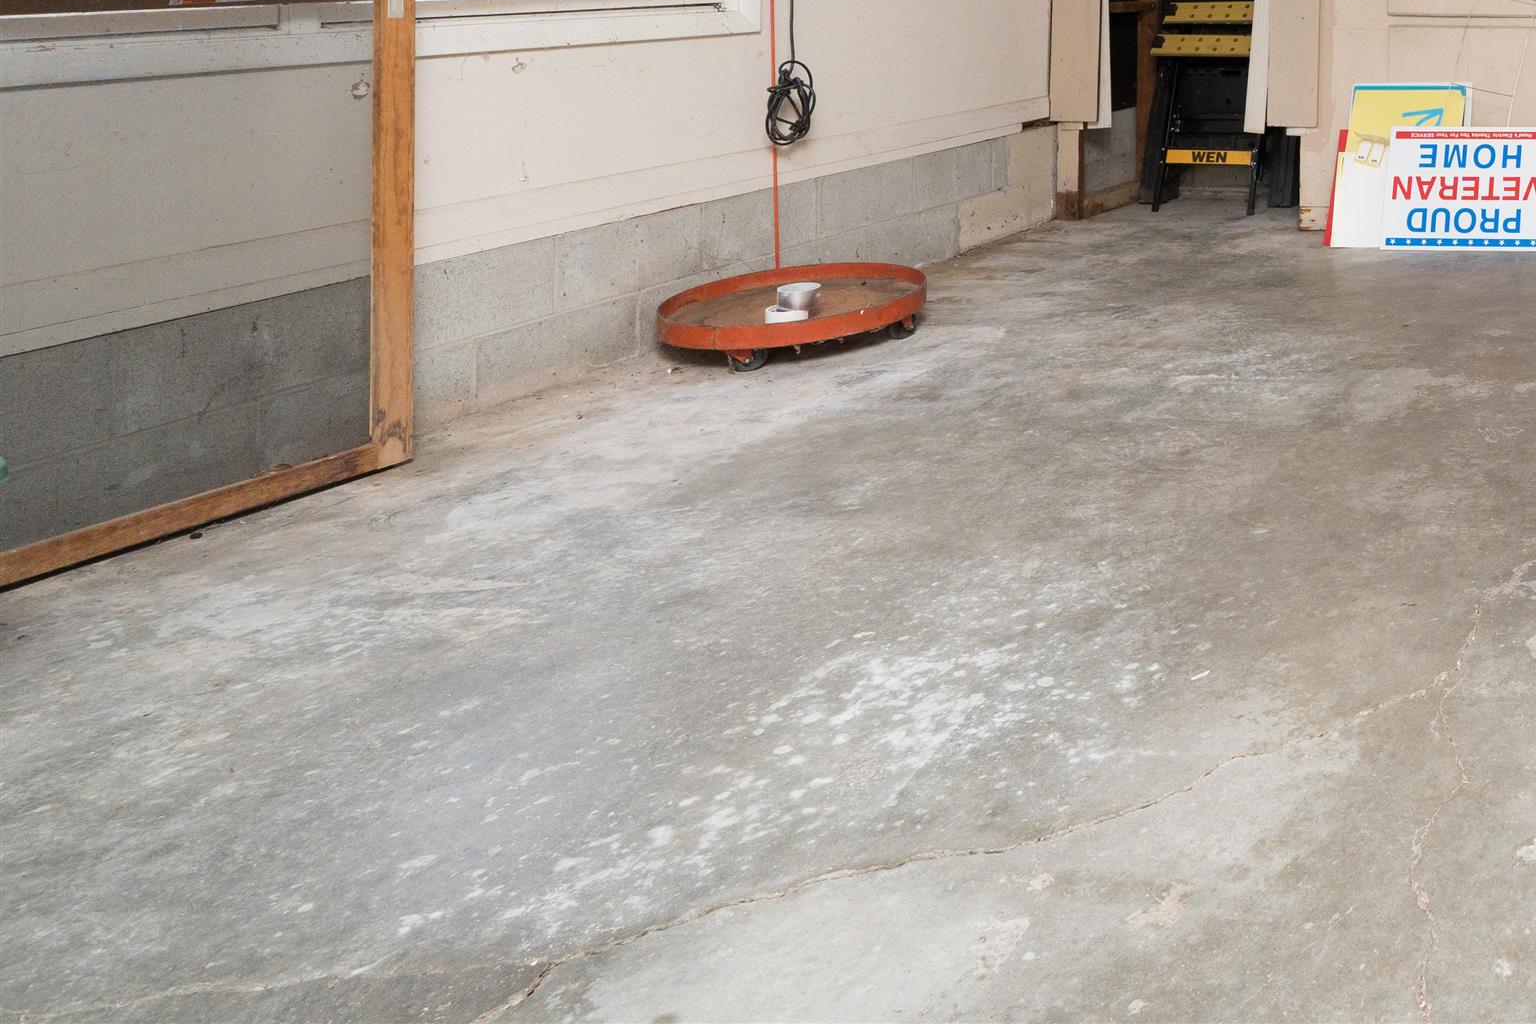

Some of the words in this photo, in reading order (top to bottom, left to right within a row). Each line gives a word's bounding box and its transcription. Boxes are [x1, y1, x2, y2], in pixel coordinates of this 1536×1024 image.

[1191, 151, 1228, 163] WEN
[1418, 143, 1522, 169] HOME
[1406, 207, 1522, 234] PROUD
